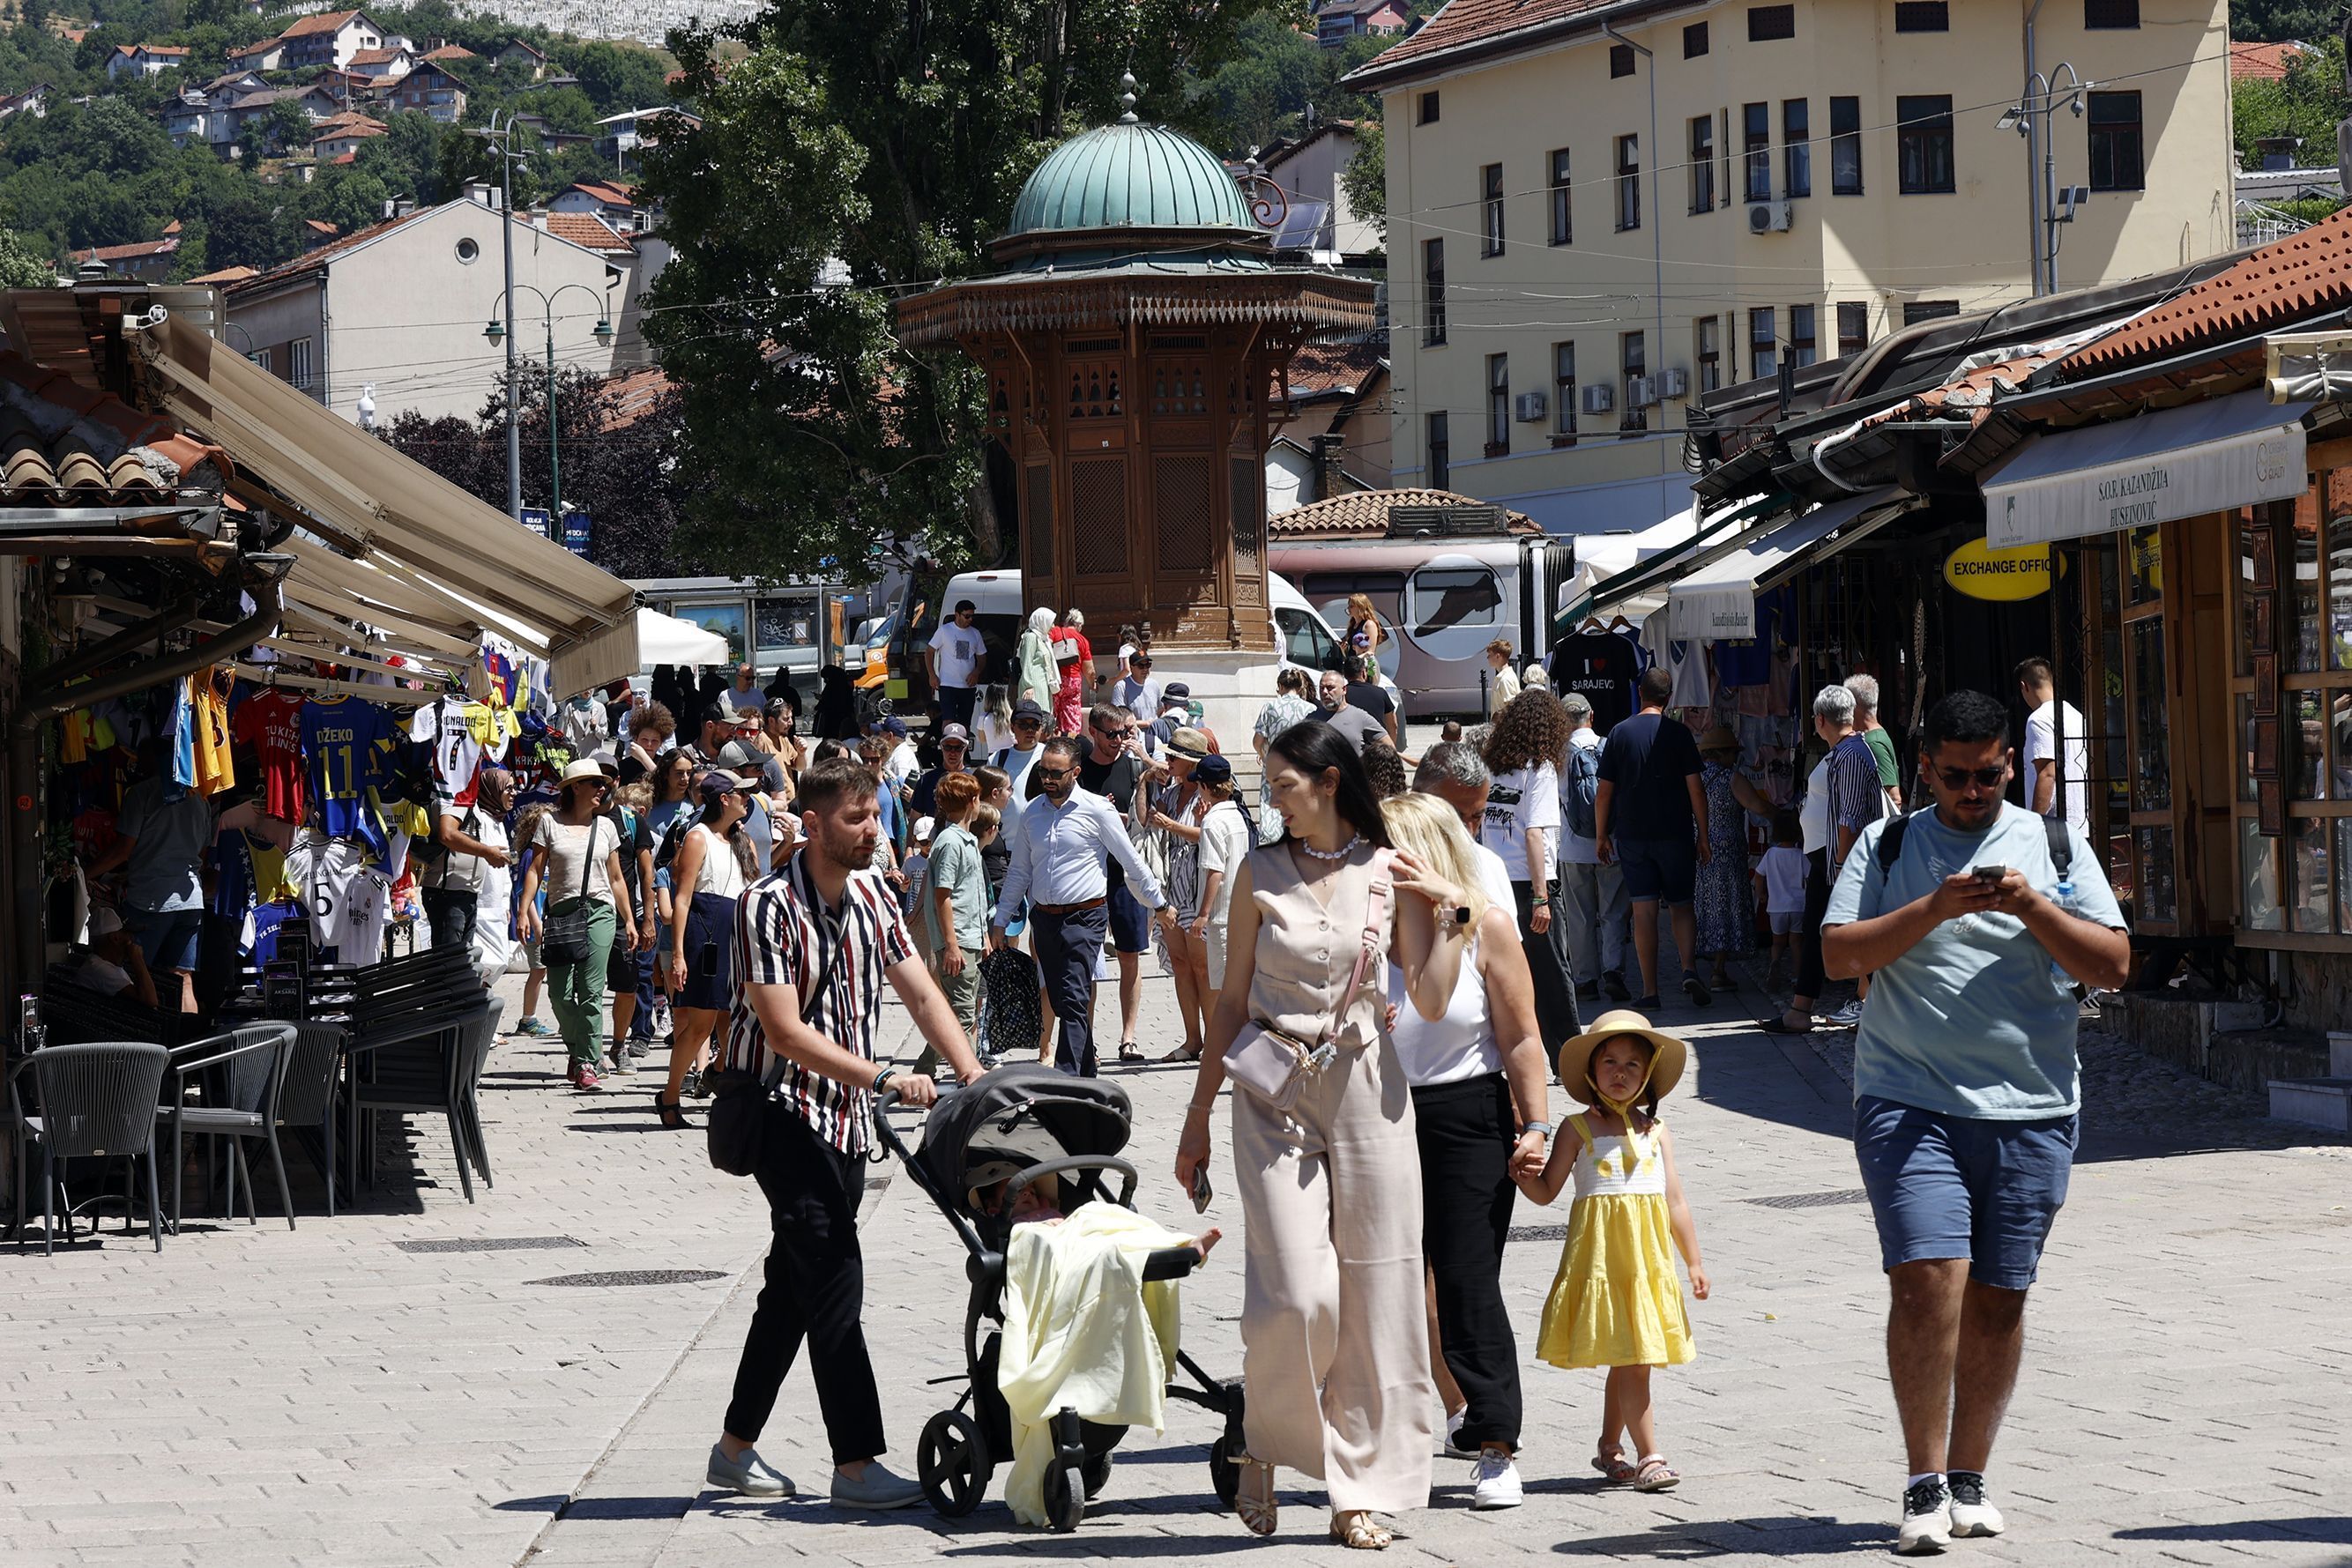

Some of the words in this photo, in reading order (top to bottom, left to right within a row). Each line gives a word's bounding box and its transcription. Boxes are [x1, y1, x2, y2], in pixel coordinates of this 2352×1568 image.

[1954, 560, 2017, 576] EXCHANGE
[2019, 558, 2051, 572] OFFIC
[1584, 658, 1590, 675] I
[1572, 679, 1615, 691] SARAJEVO
[316, 726, 354, 744] DŽEKO
[447, 729, 467, 771] 7
[317, 745, 358, 800] 11
[301, 868, 343, 881] BELLINGHAM
[314, 881, 333, 917] 5
